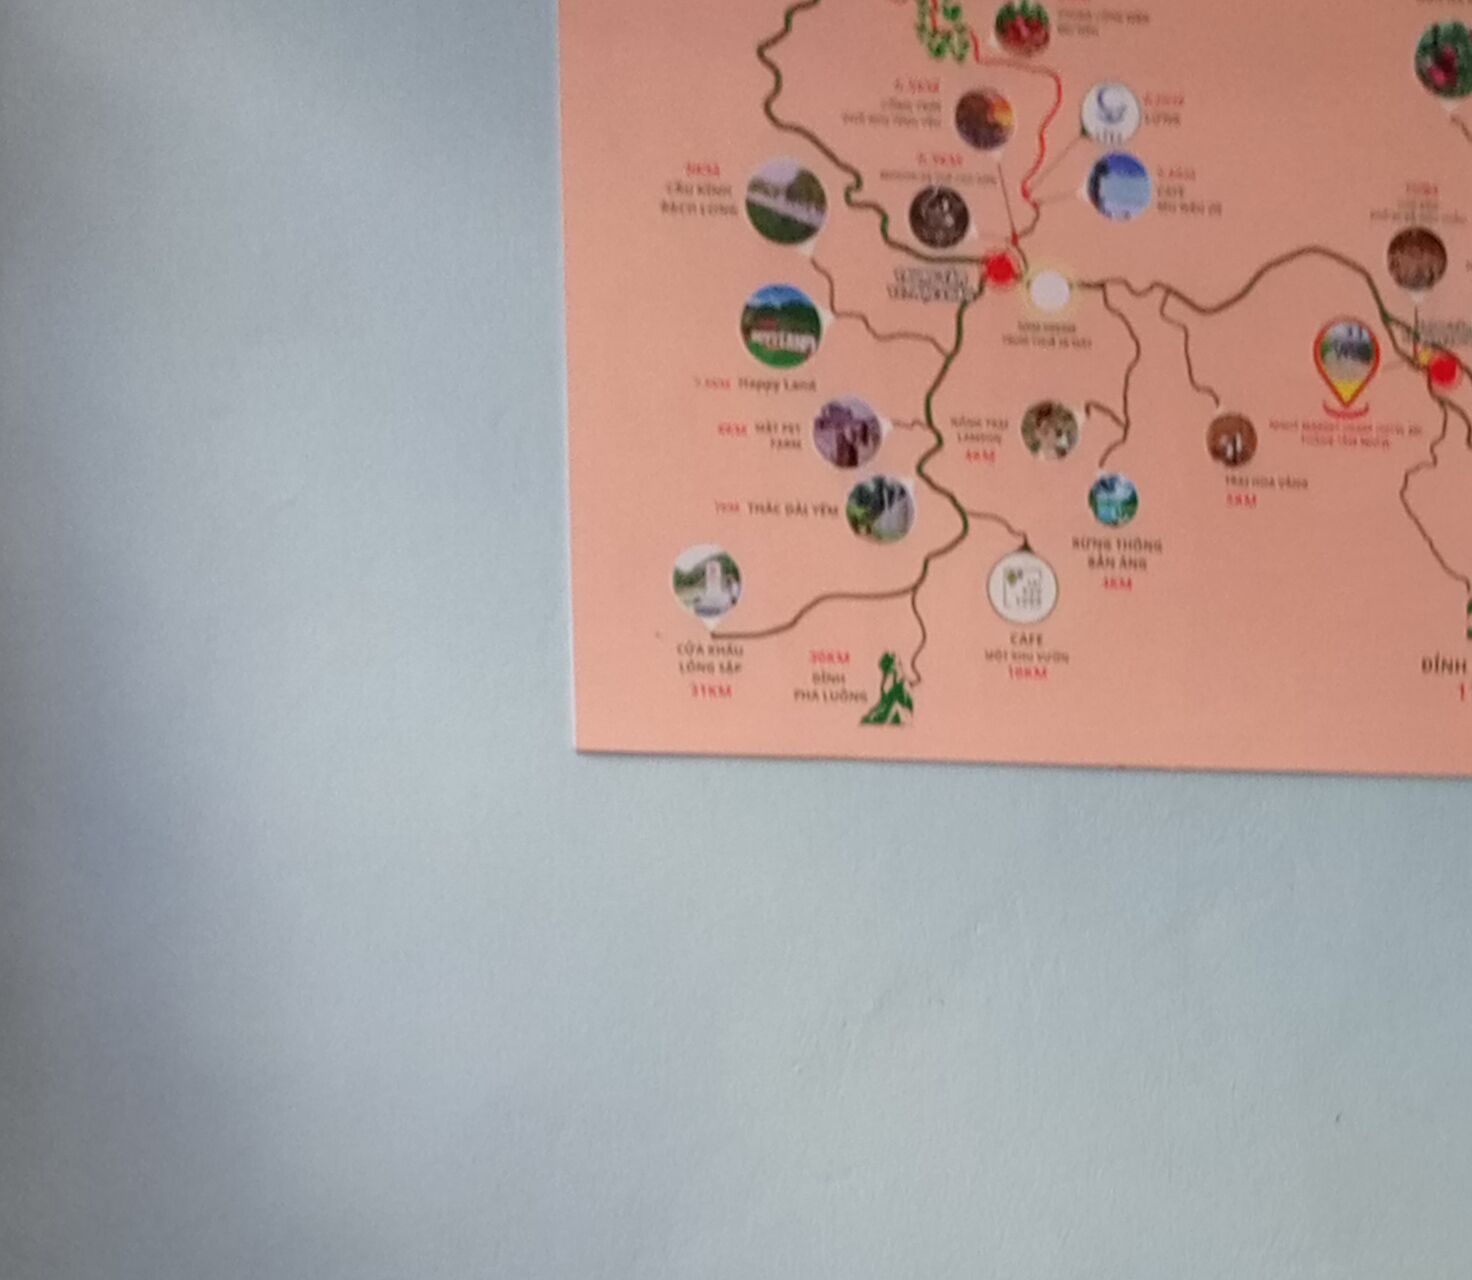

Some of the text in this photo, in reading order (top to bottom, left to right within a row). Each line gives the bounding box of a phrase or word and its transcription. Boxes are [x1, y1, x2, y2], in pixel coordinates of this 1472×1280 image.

[738, 377, 817, 395] Happy Land
[748, 501, 780, 515] THÁC
[1115, 536, 1163, 553] THÔNG
[1009, 632, 1043, 646] CAFE
[1420, 651, 1467, 675] ĐỈNH
